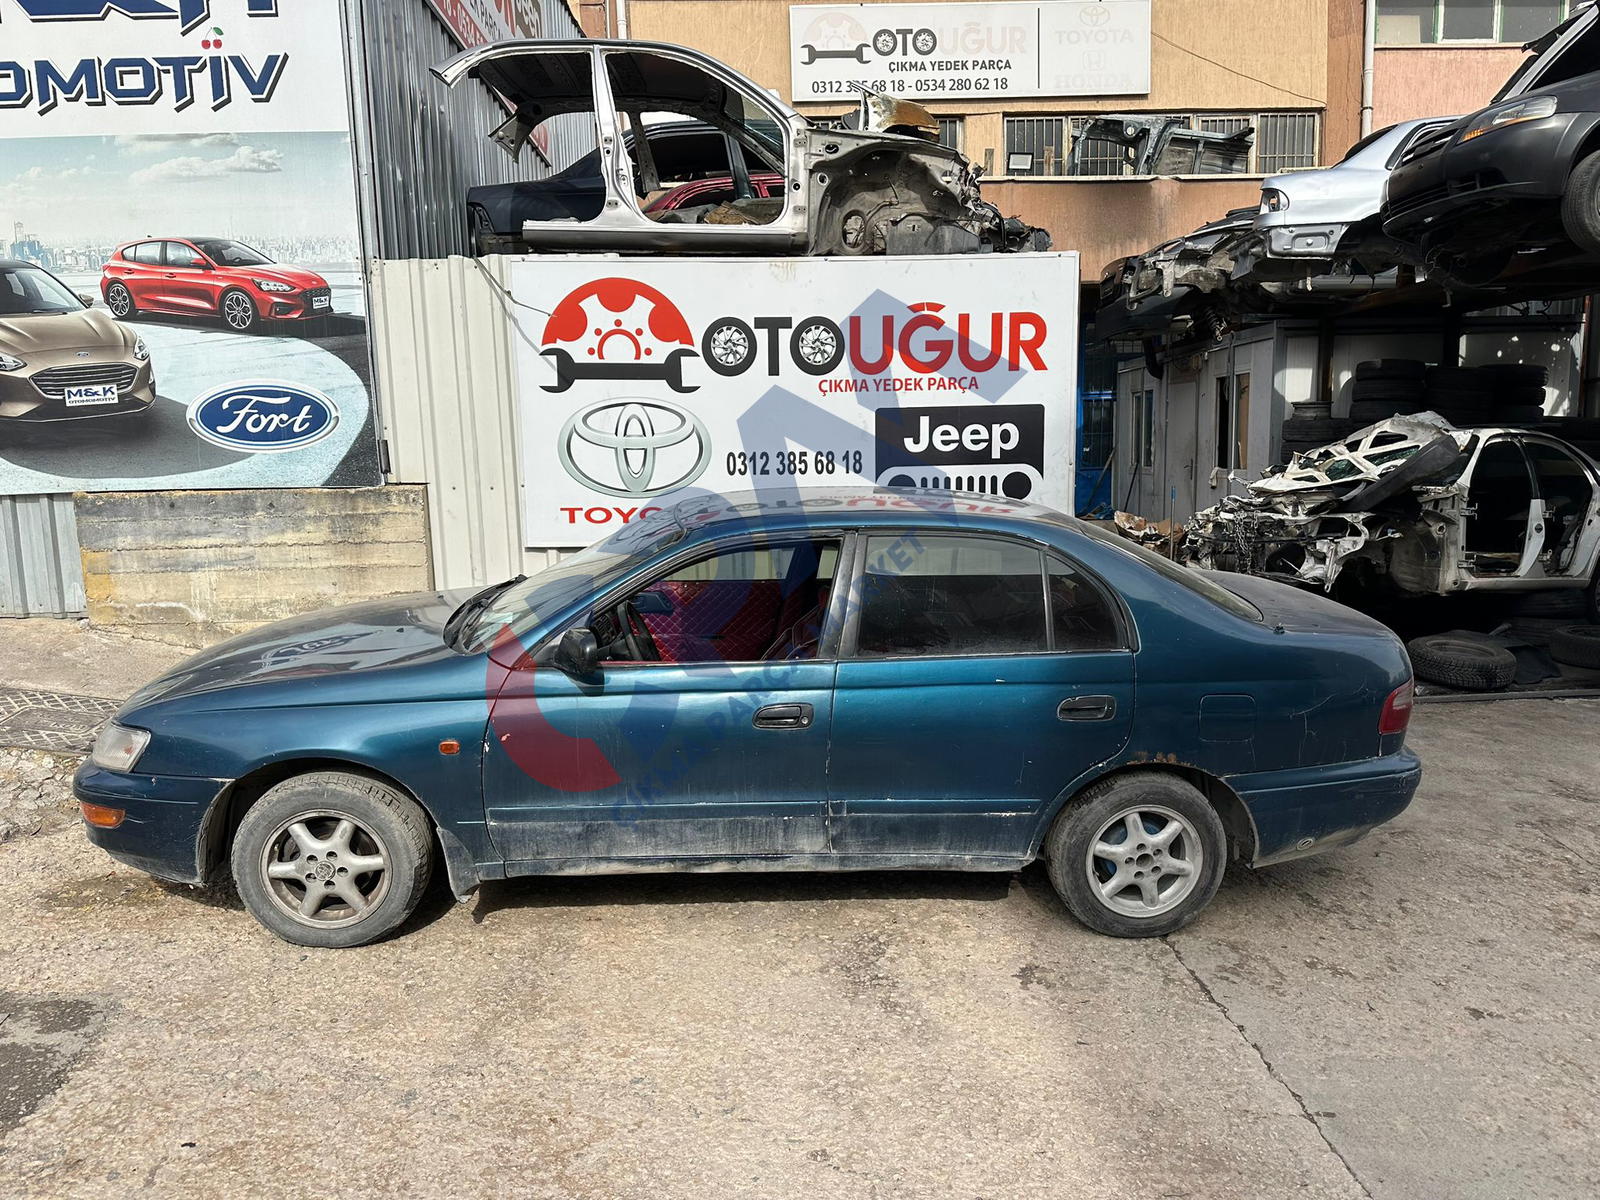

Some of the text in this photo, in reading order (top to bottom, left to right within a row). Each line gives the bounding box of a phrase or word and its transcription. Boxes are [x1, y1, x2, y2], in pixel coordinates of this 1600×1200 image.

[1055, 28, 1134, 45] TOYOTA
[888, 59, 1012, 74] ÇIKMA YEDEK PARÇA
[811, 80, 843, 94] 0312
[890, 79, 905, 92] 18
[915, 79, 946, 92] 0534
[949, 78, 972, 91] 280
[974, 78, 990, 91] 62
[993, 77, 1009, 90] 18
[818, 375, 979, 396] ÇIKMA YEDEK PARÇA
[216, 394, 313, 433] Fort
[903, 415, 1020, 459] Jeep
[726, 450, 863, 476] 0312 385 68 18
